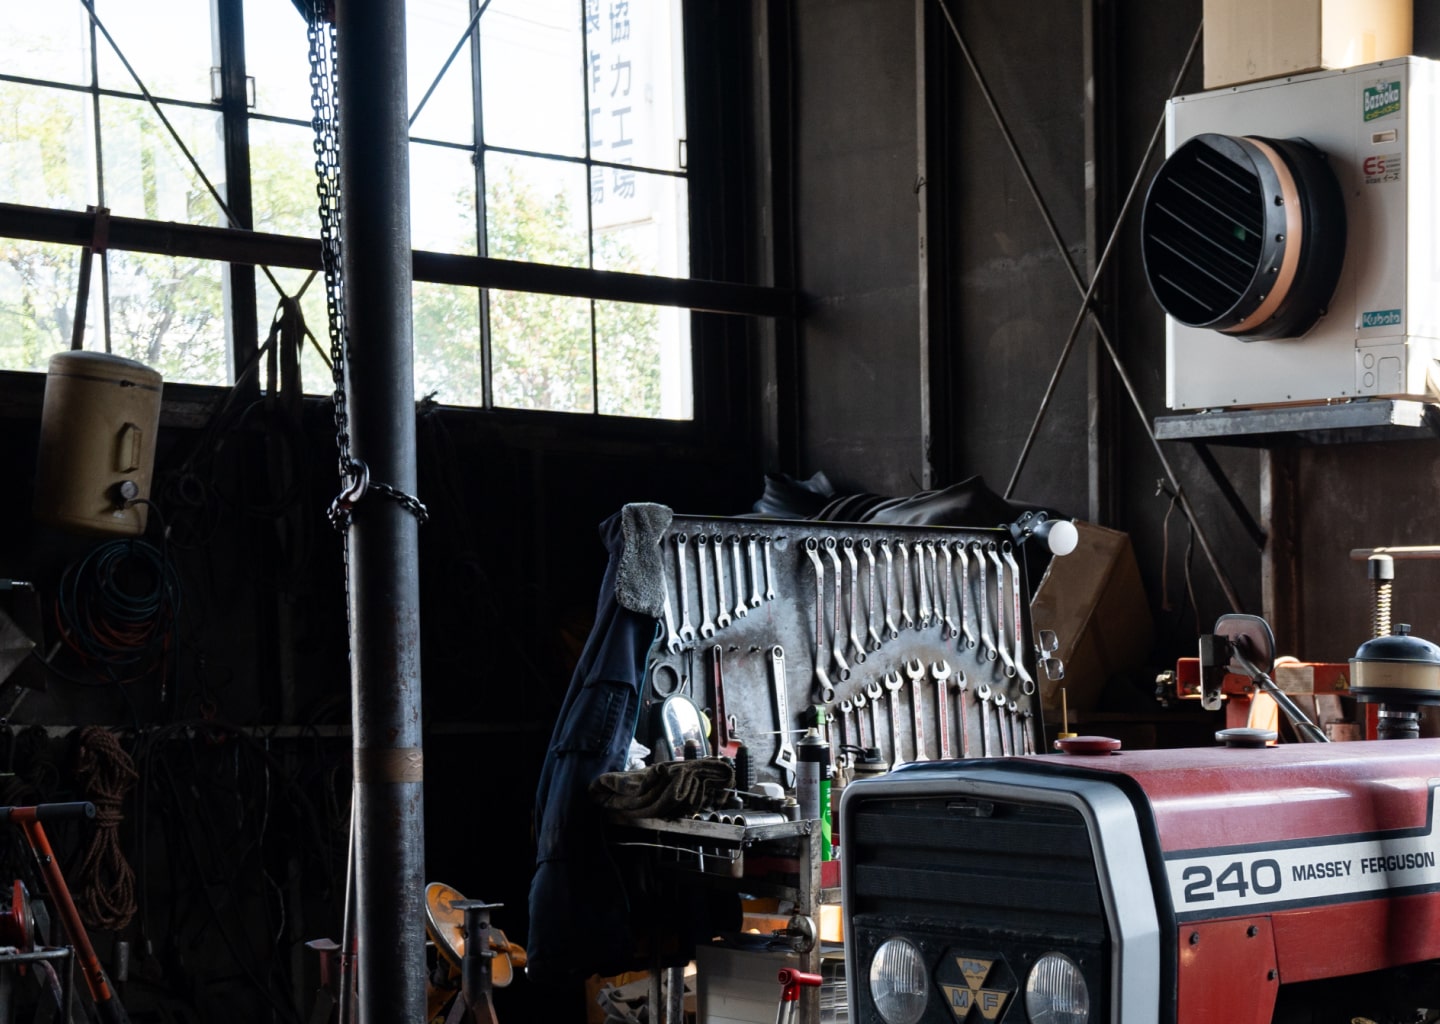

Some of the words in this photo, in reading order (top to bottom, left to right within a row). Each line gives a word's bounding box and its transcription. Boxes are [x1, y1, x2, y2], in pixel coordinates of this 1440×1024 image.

[609, 0, 635, 199] 協力工場
[1364, 84, 1399, 112] Bazooka
[1363, 311, 1399, 326] Kubota
[1182, 859, 1282, 902] 240
[1292, 860, 1352, 882] MASSEY
[1361, 851, 1436, 874] FERGUSON
